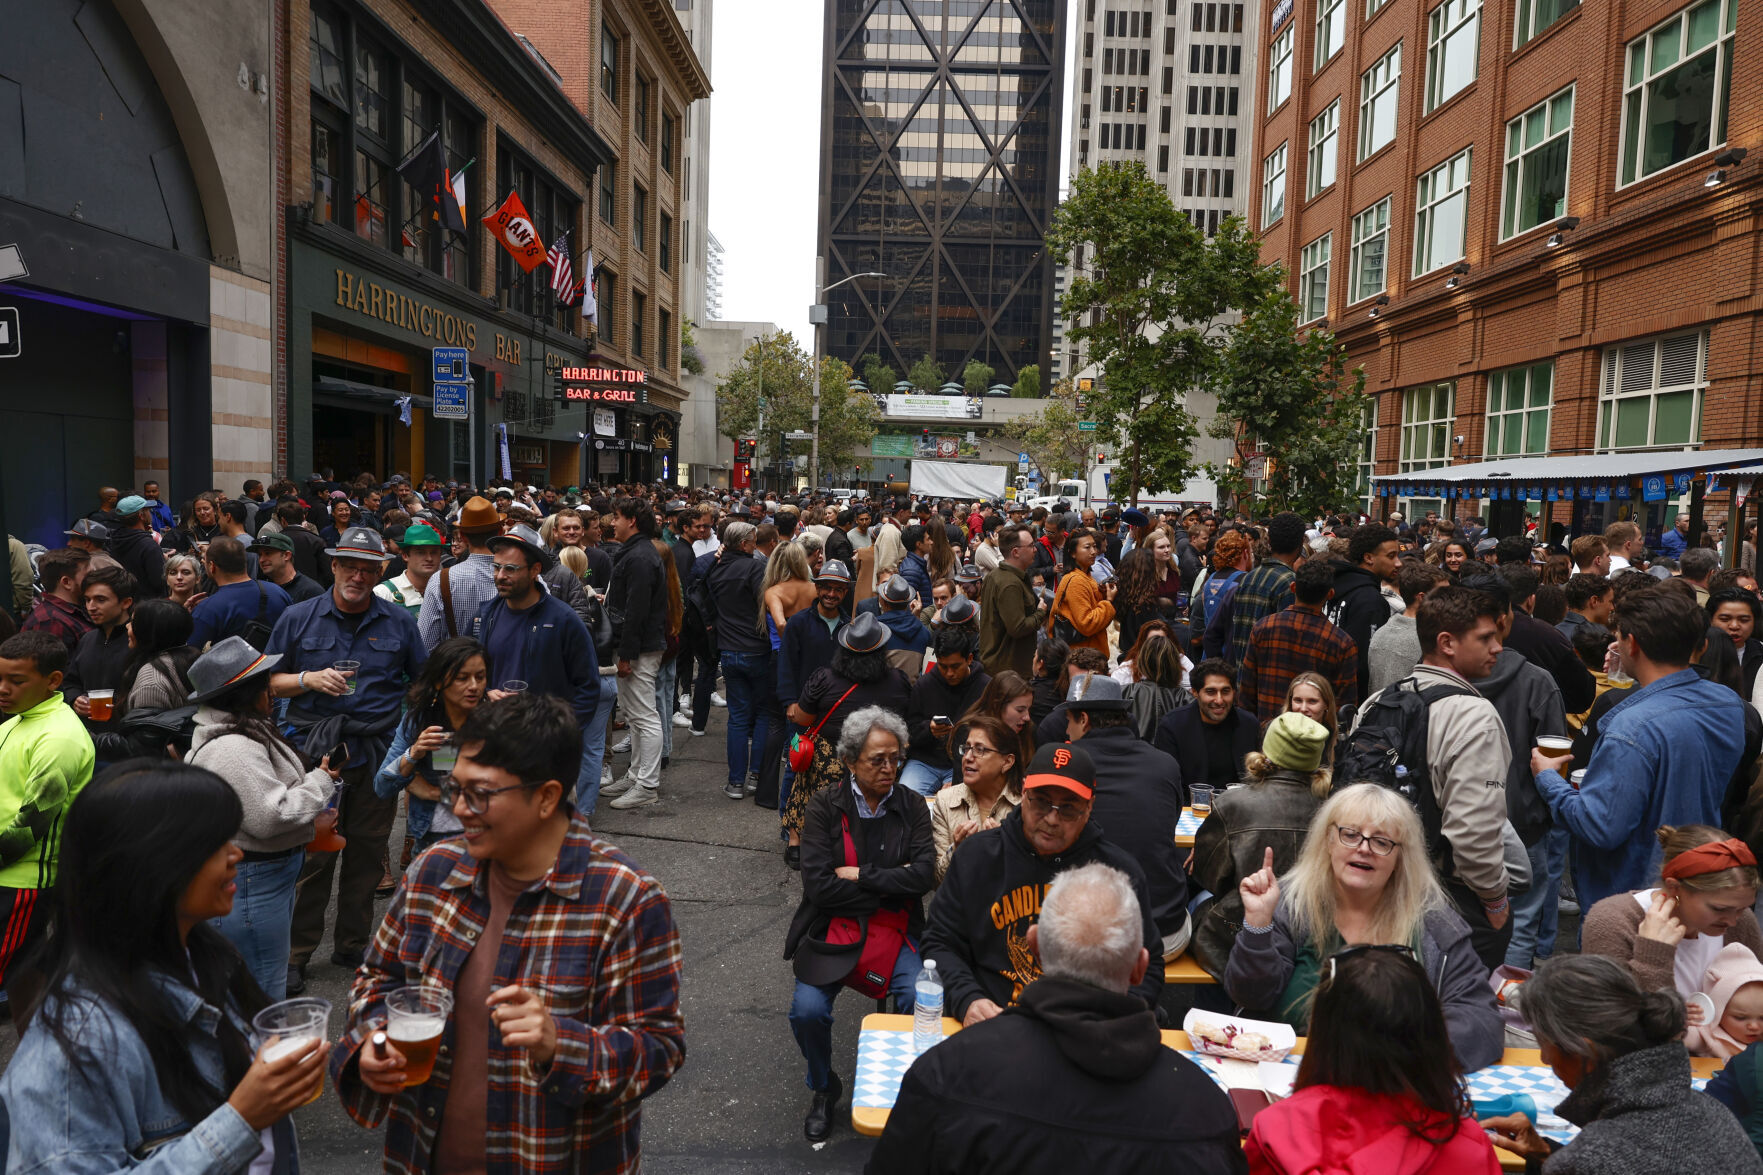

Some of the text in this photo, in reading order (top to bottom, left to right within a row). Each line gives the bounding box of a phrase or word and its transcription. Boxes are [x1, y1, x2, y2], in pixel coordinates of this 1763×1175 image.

[498, 212, 539, 257] GIANTS
[336, 268, 476, 351] HARRINGTONS
[495, 333, 521, 366] BAR
[435, 351, 448, 359] Pay
[562, 367, 645, 383] HARRINGTON
[436, 385, 448, 393] Pay
[566, 388, 591, 399] BAR
[592, 391, 600, 400] &
[1020, 453, 1029, 462] P
[1053, 748, 1072, 768] SF
